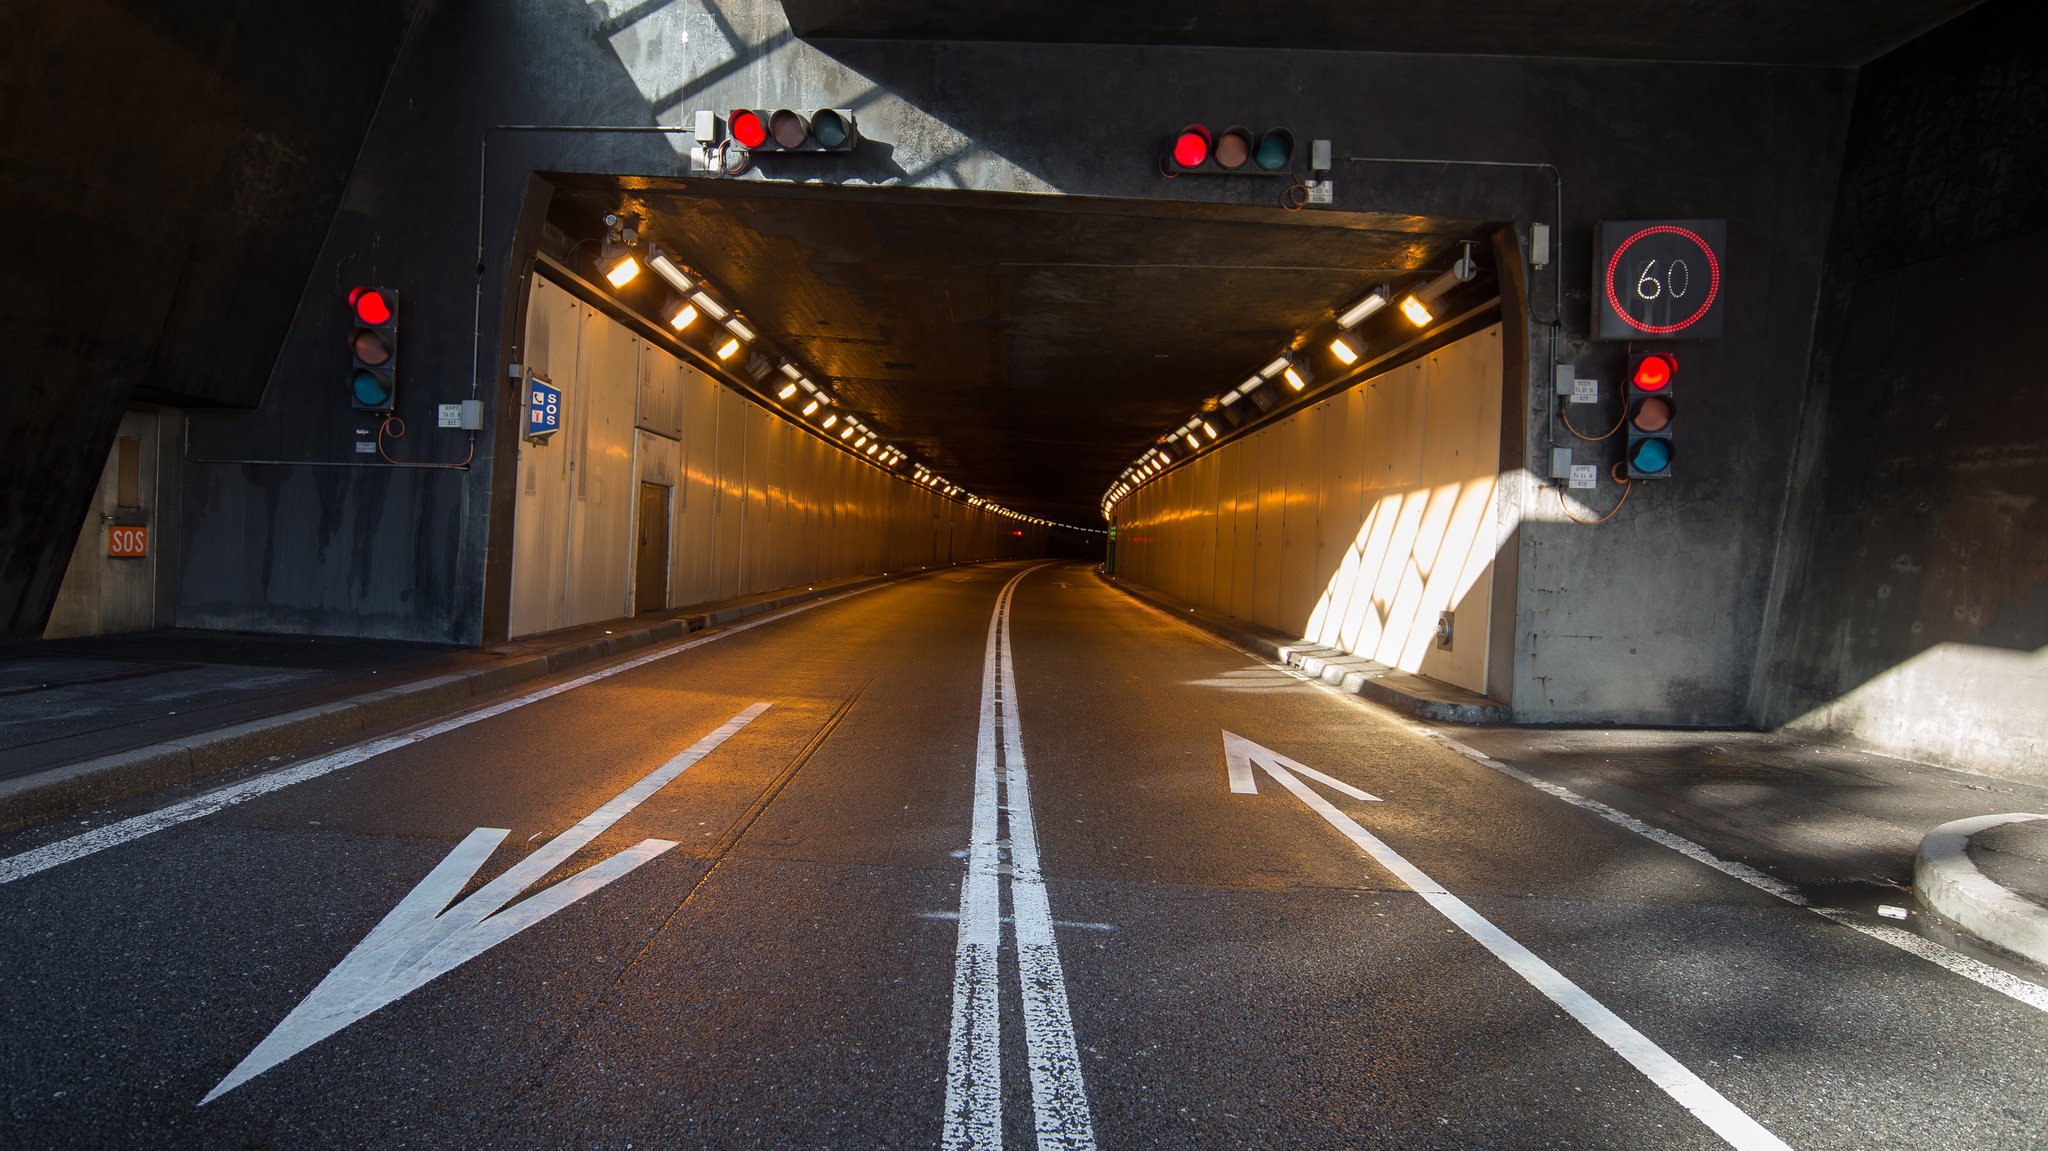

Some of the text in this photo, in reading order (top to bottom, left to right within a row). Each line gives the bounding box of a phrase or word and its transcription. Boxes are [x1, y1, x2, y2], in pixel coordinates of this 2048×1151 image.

[1637, 259, 1689, 300] 60
[546, 393, 557, 425] SOS
[112, 530, 144, 553] SOS
